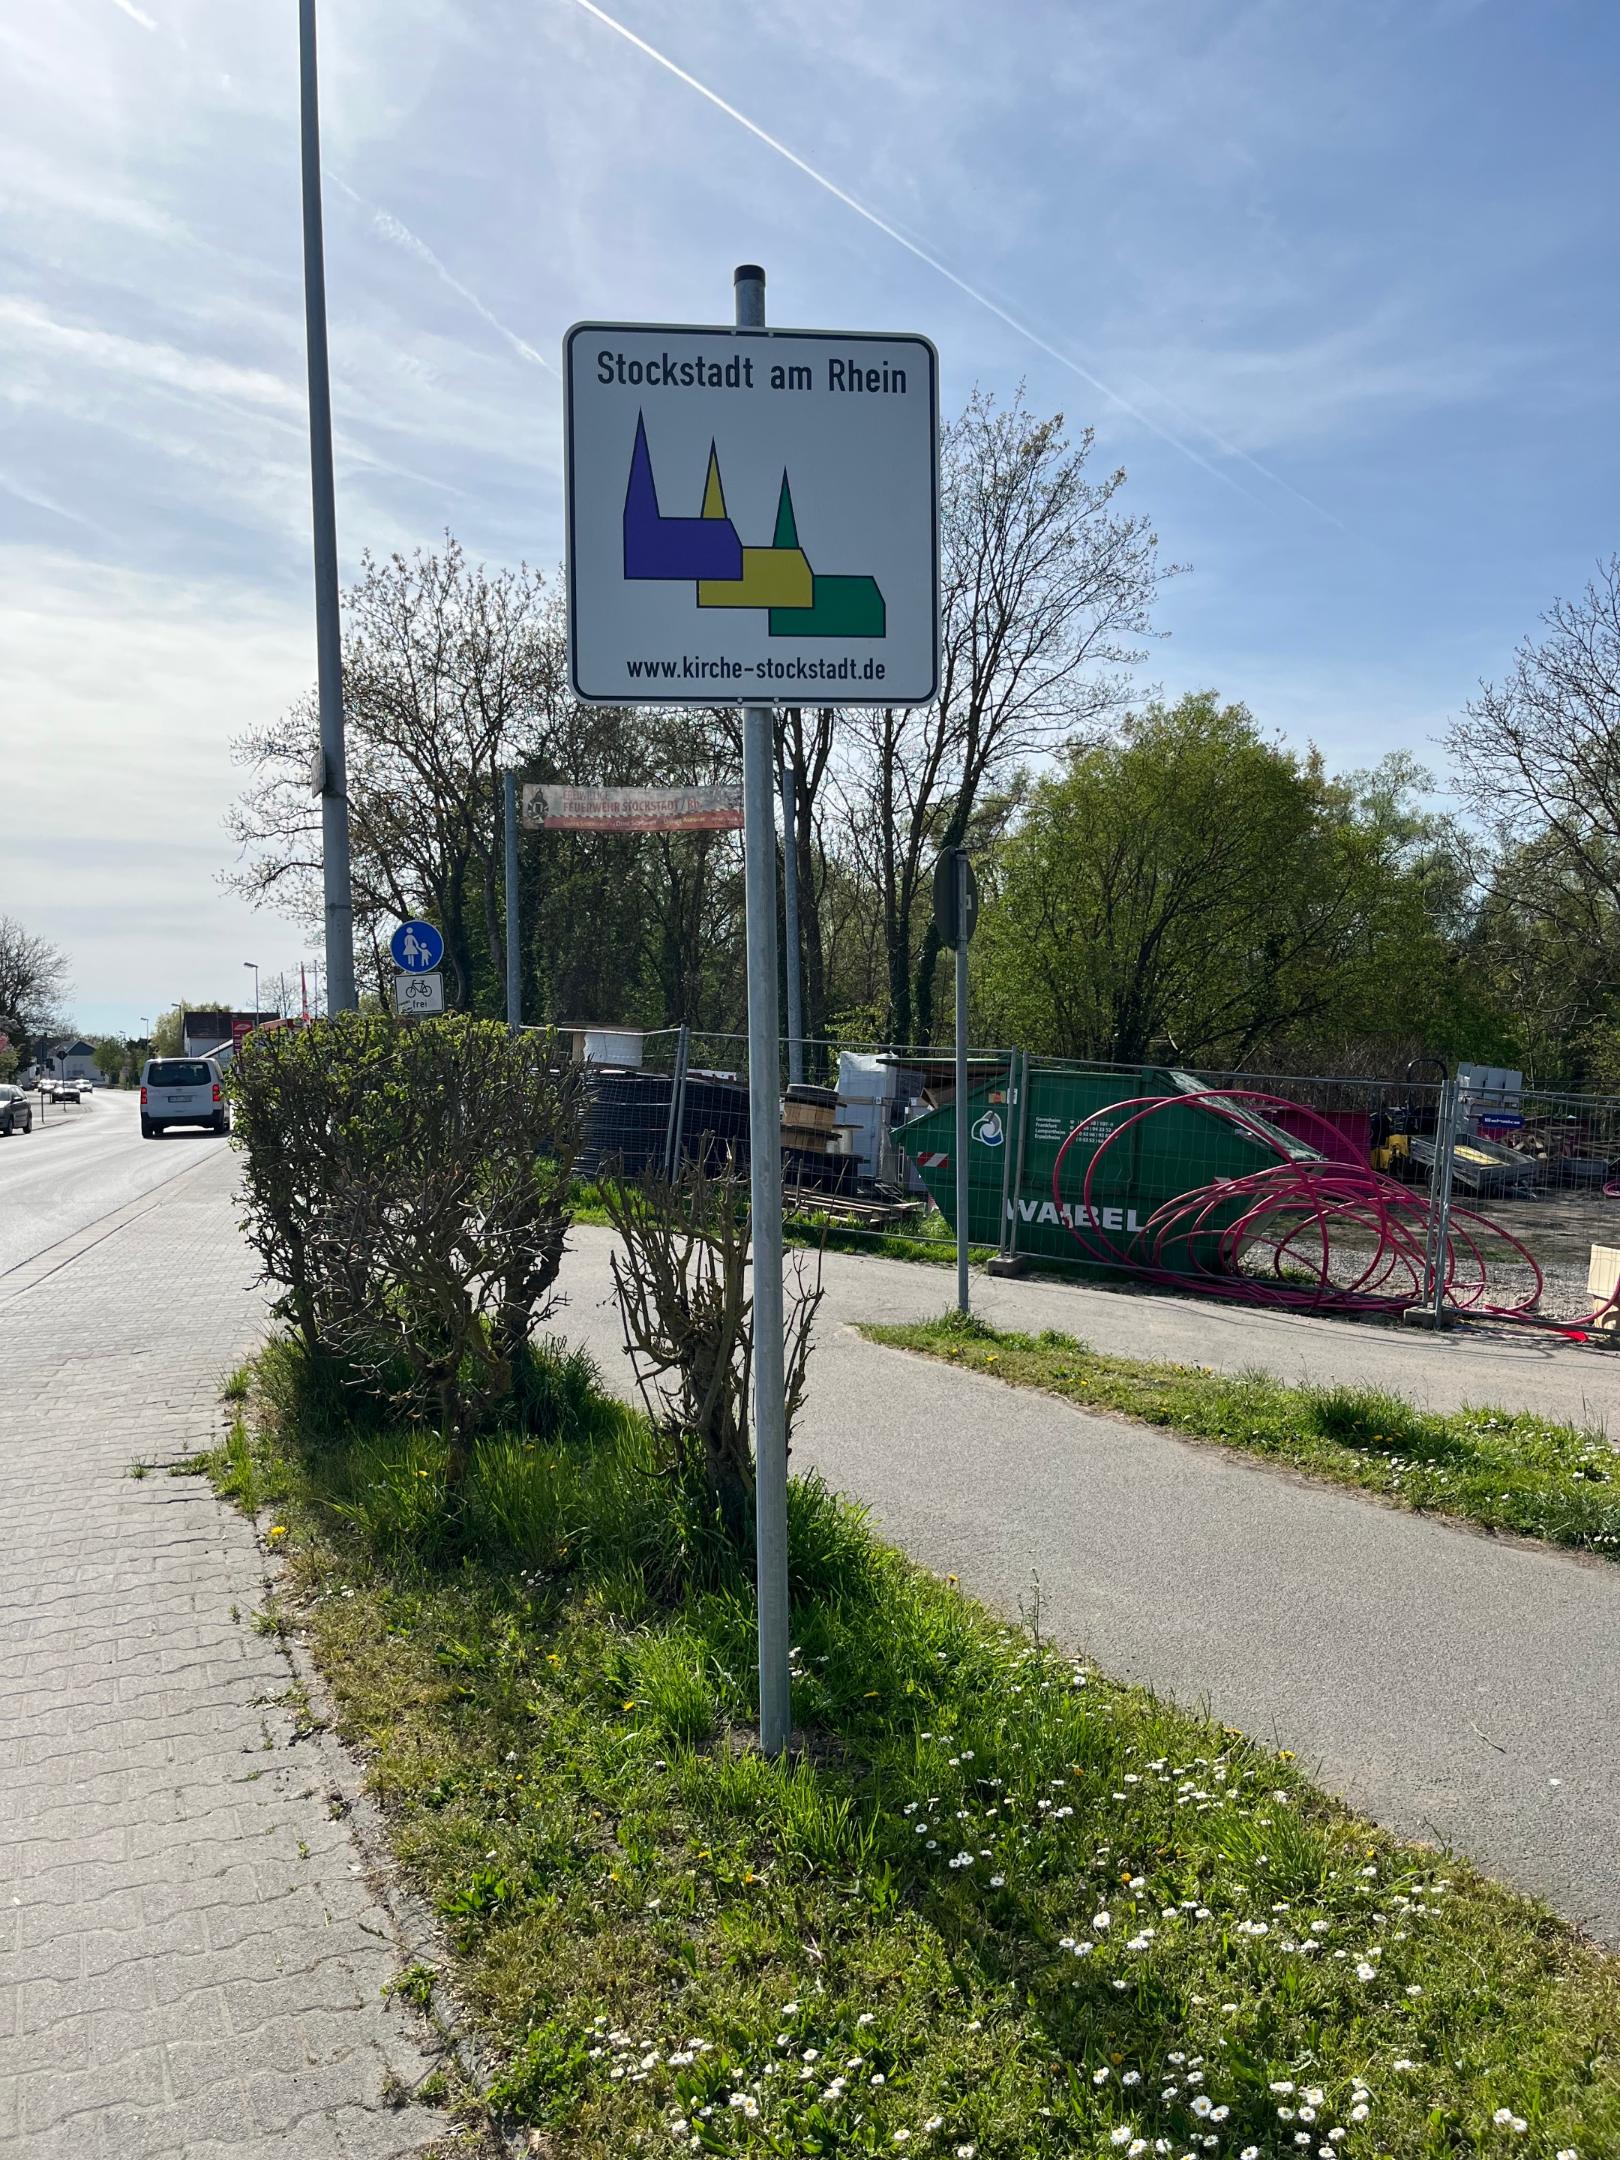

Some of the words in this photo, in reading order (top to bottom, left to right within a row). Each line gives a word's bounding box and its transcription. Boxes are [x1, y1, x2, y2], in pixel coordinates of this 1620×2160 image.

[597, 350, 754, 388] Stockstadt
[770, 364, 812, 391] am
[828, 358, 907, 394] Rhein
[626, 656, 886, 681] www.kirche-stockstadt.de
[563, 801, 620, 813] FEUERWEHR
[622, 799, 679, 812] STOCKSTADT
[412, 999, 427, 1009] frei
